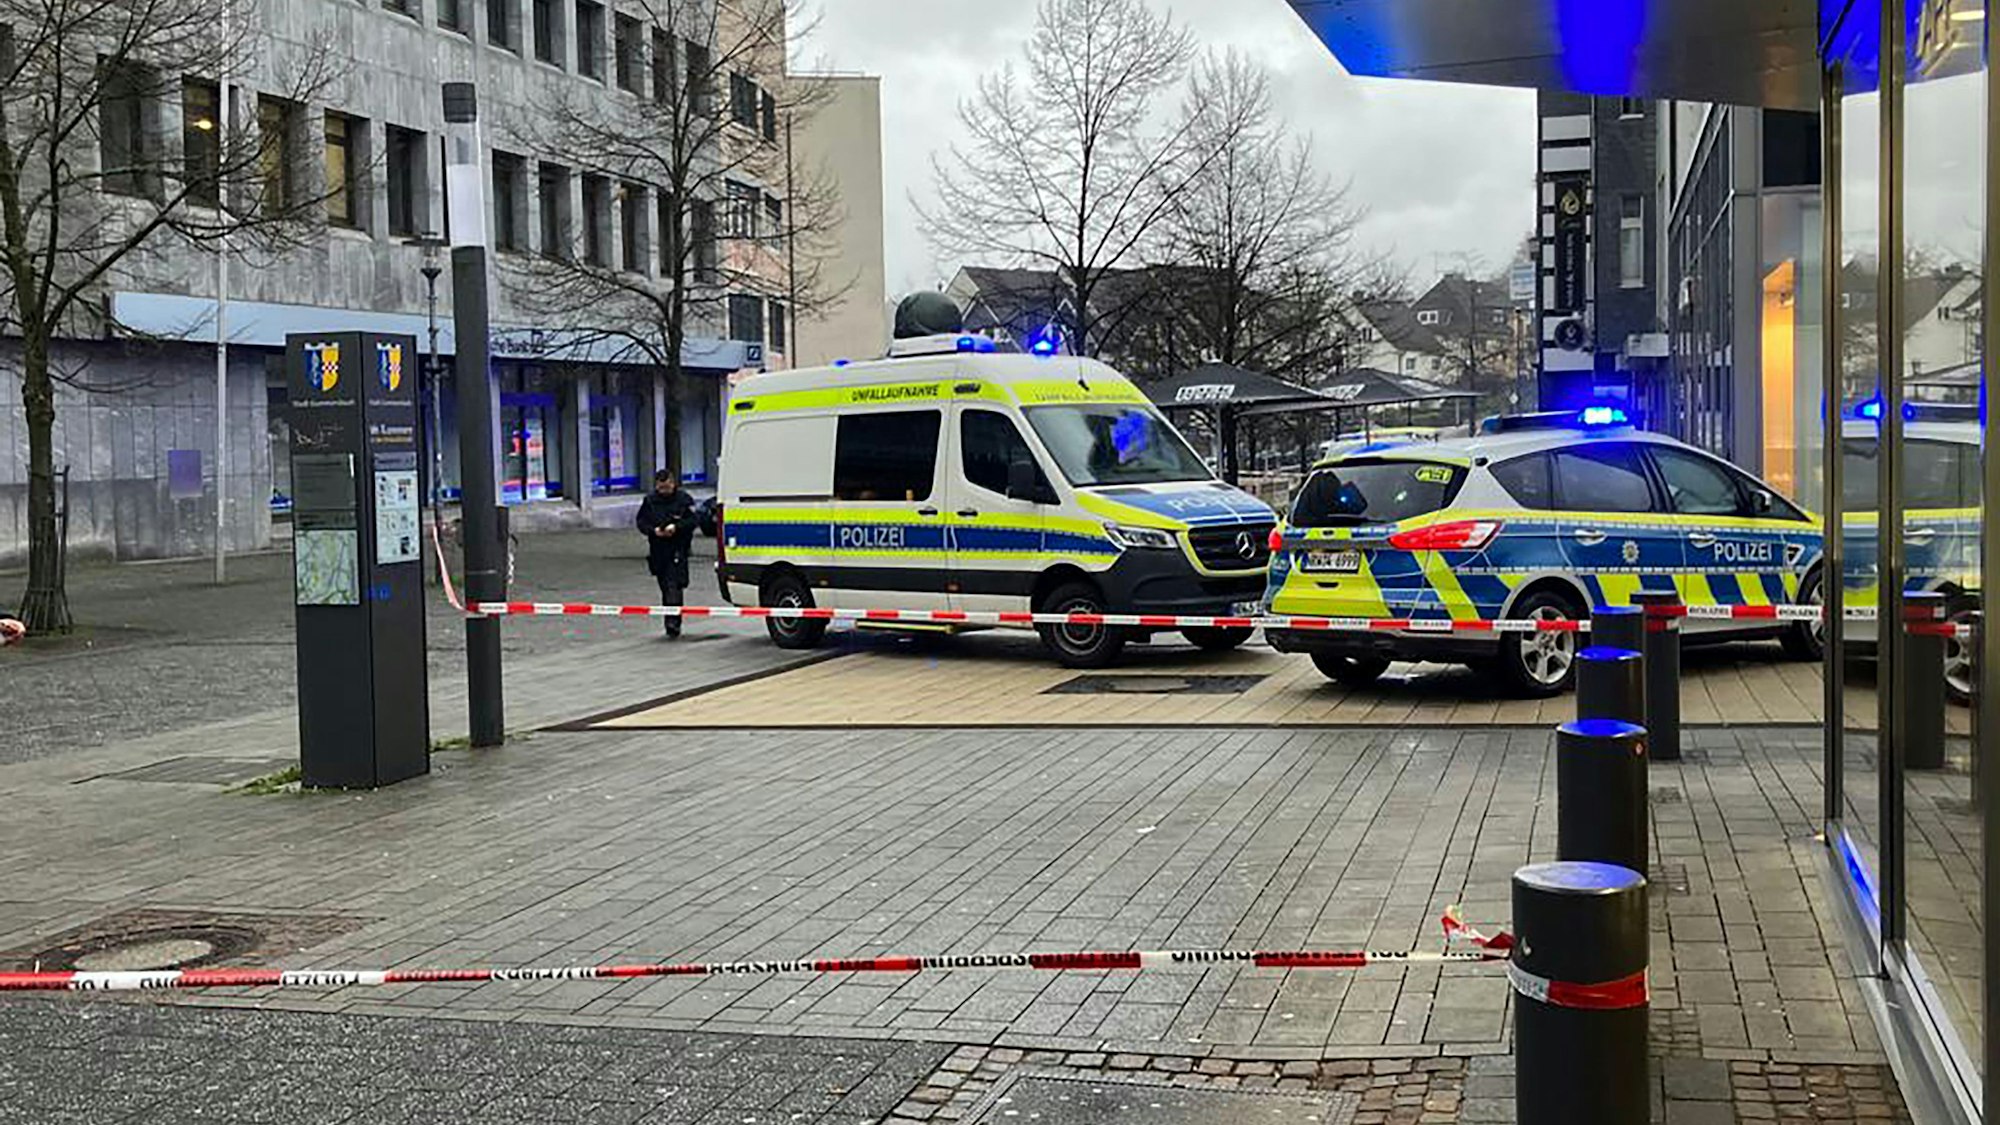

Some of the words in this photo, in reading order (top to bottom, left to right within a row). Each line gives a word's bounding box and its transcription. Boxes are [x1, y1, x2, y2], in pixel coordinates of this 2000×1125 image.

[851, 383, 939, 401] UNFALLAUFNAHME
[840, 526, 905, 547] POLIZEI
[1714, 541, 1773, 562] POLIZEI
